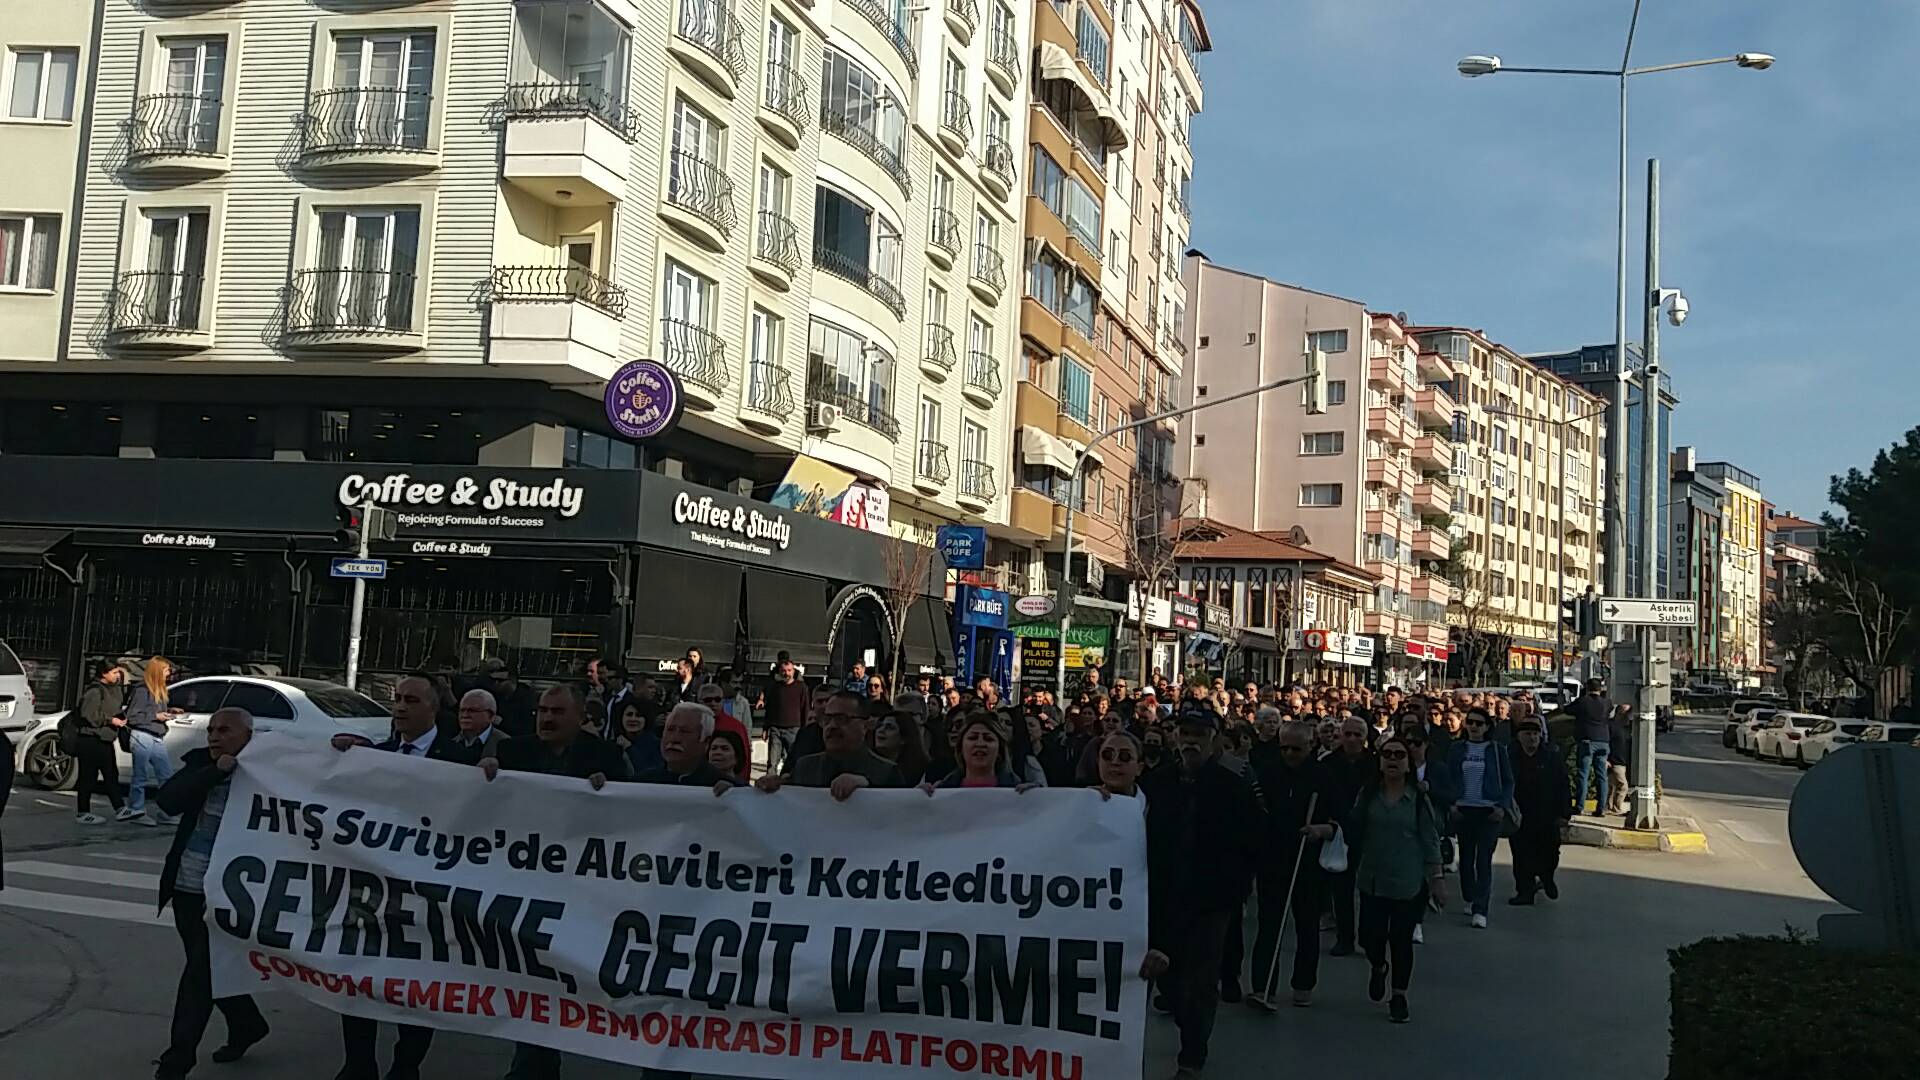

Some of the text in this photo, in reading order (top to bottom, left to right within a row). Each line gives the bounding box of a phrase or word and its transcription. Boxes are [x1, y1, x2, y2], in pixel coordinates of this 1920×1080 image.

[619, 372, 661, 394] Coffee
[619, 404, 661, 425] Study
[339, 474, 584, 518] Coffee & Study
[398, 514, 544, 528] Rejoicing Formula of Success
[674, 491, 791, 550] Coffee & Study
[142, 533, 216, 549] Coffee & Study
[412, 541, 491, 557] Coffee & Study
[946, 538, 972, 548] PARK
[946, 548, 971, 557] BÜFE
[1676, 523, 1686, 580] HOTEL
[969, 598, 986, 613] PARK
[986, 598, 1002, 616] BÜFE
[1650, 603, 1692, 613] Askerlik
[1658, 613, 1692, 623] Şubesi
[957, 633, 967, 678] PARK
[1023, 649, 1056, 657] PILATES
[1024, 658, 1054, 667] STUDIO
[245, 793, 1124, 920] HTŞ Suriye'de Alevileri Katlediyor!
[214, 855, 1125, 1041] SEYRETME, GEÇİT VERME!
[248, 950, 1084, 1080] ÇORUM EMEK VE DEMOKRASİ PLATFORMU
